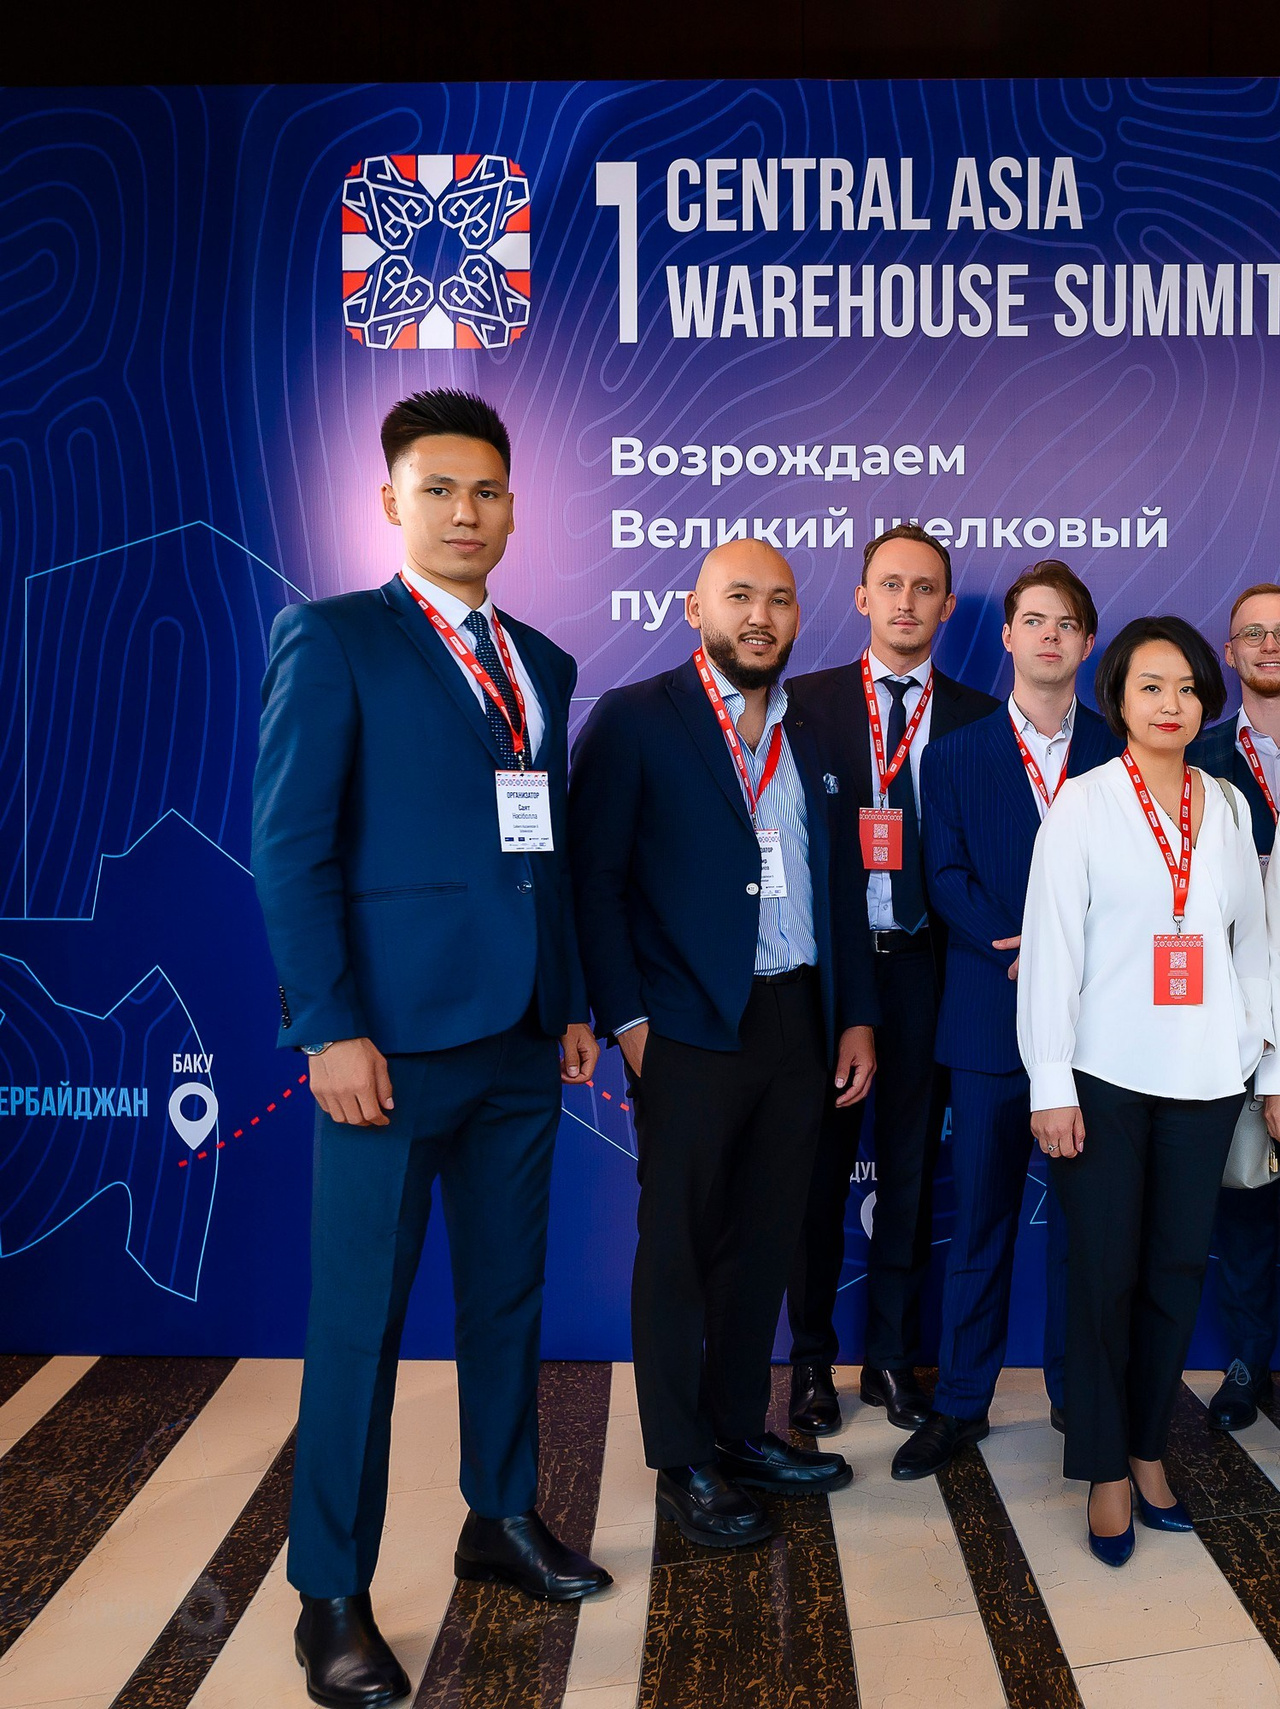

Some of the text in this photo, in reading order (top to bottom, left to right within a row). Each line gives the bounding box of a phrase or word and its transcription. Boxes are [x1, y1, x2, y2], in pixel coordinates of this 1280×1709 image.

[666, 156, 1083, 232] CENTRAL ASIA
[596, 162, 637, 343] 1
[666, 264, 1029, 338] WAREHOUSE
[610, 437, 966, 485] Возрождаем
[611, 507, 854, 548] Великий
[172, 1053, 214, 1073] БАКУ
